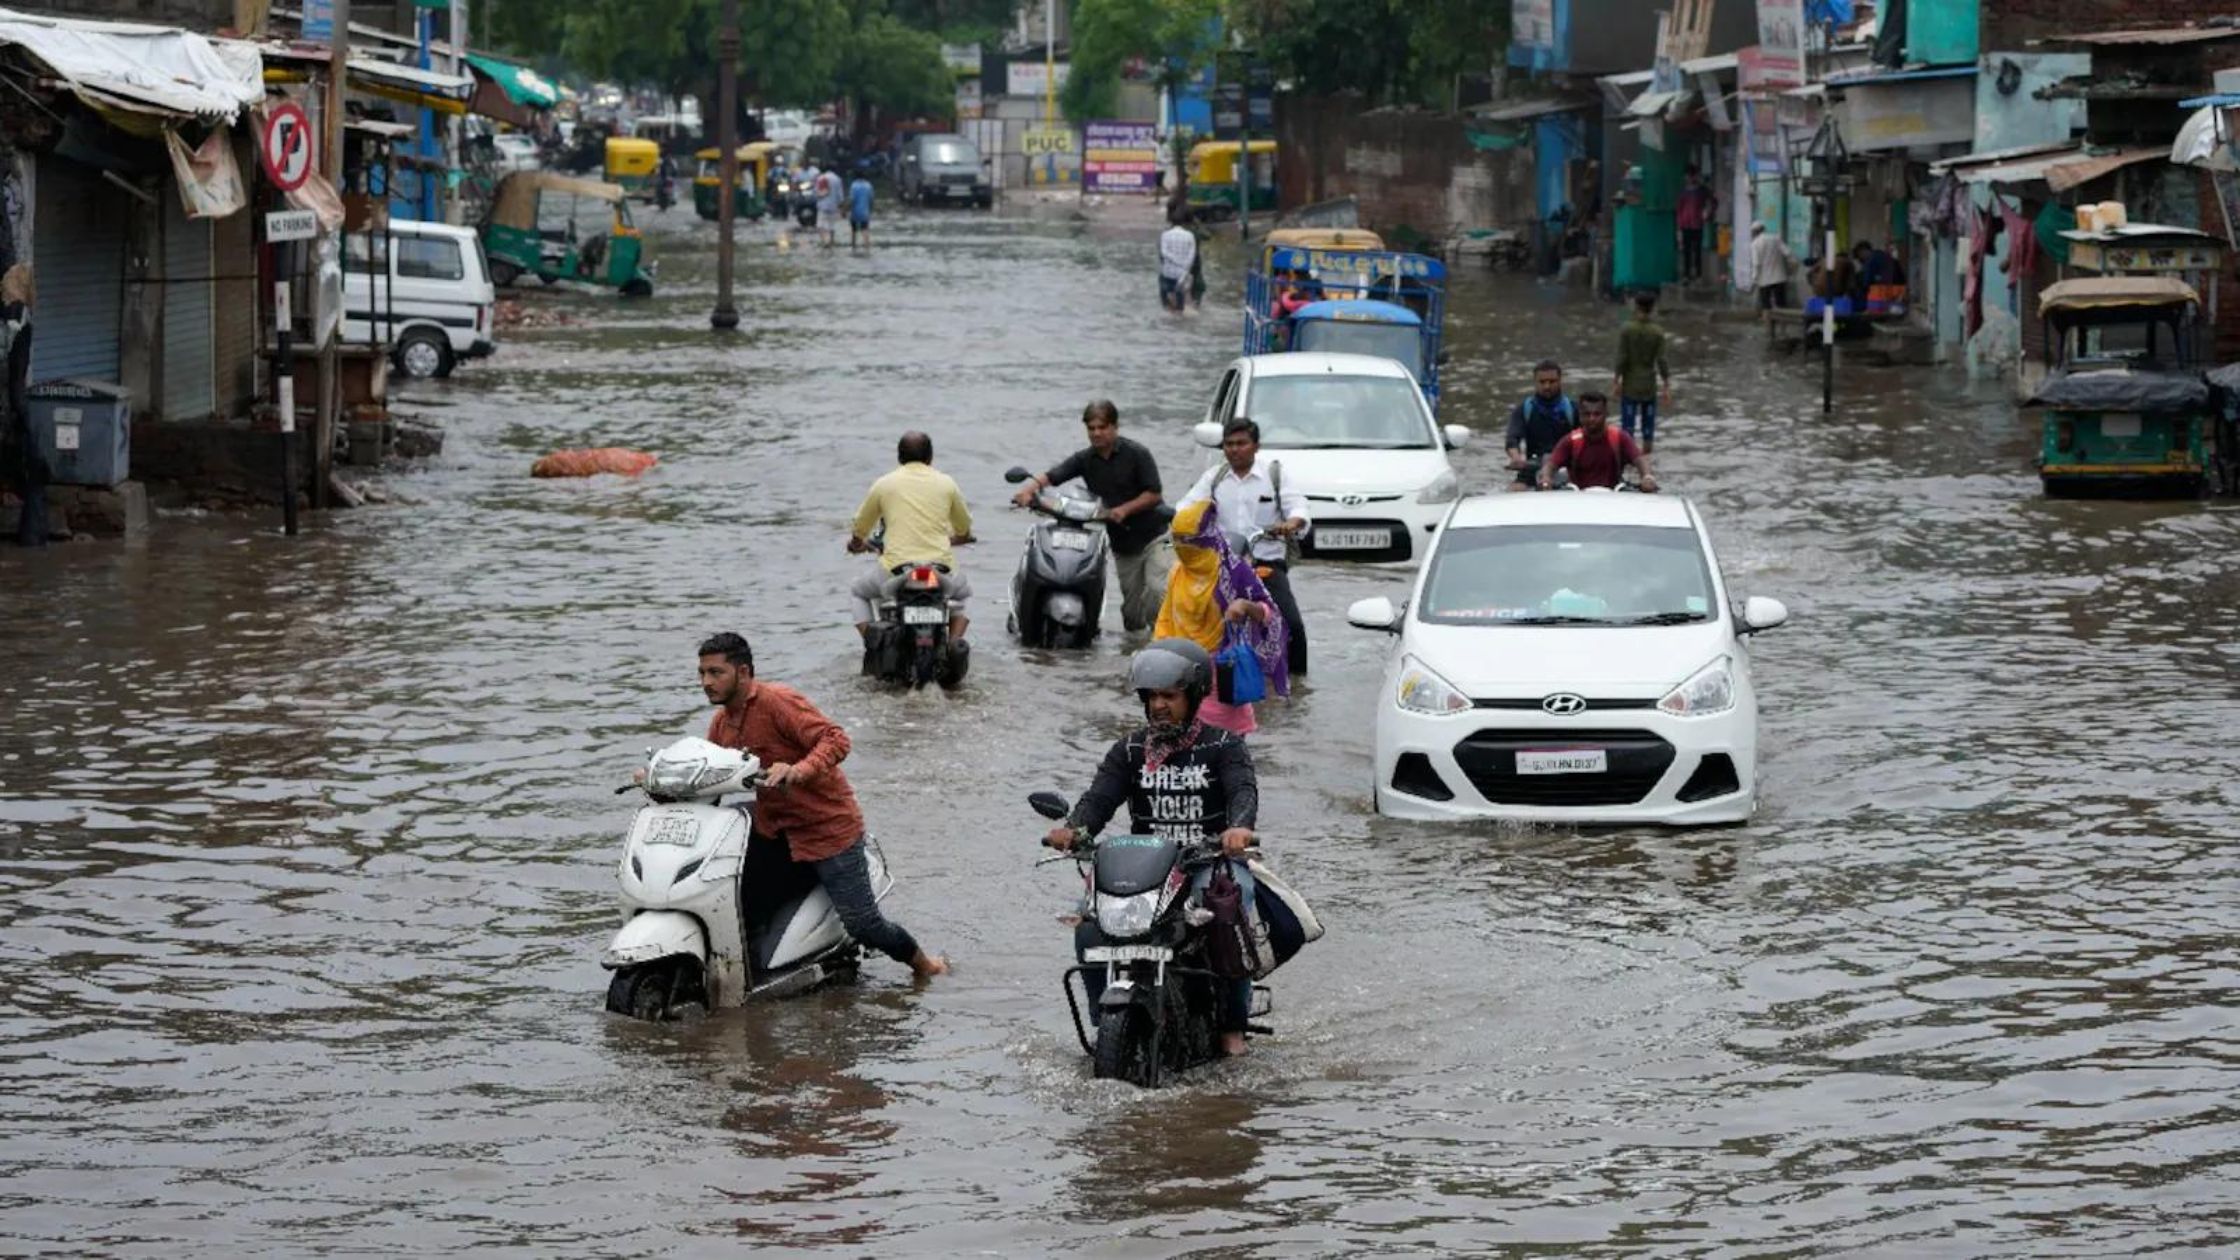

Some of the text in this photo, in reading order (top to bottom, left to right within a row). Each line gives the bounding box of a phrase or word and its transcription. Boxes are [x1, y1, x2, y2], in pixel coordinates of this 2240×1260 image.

[1026, 136, 1067, 151] PUC
[271, 219, 281, 233] NO
[1138, 764, 1211, 790] BREAK
[1147, 795, 1204, 820] YOUR
